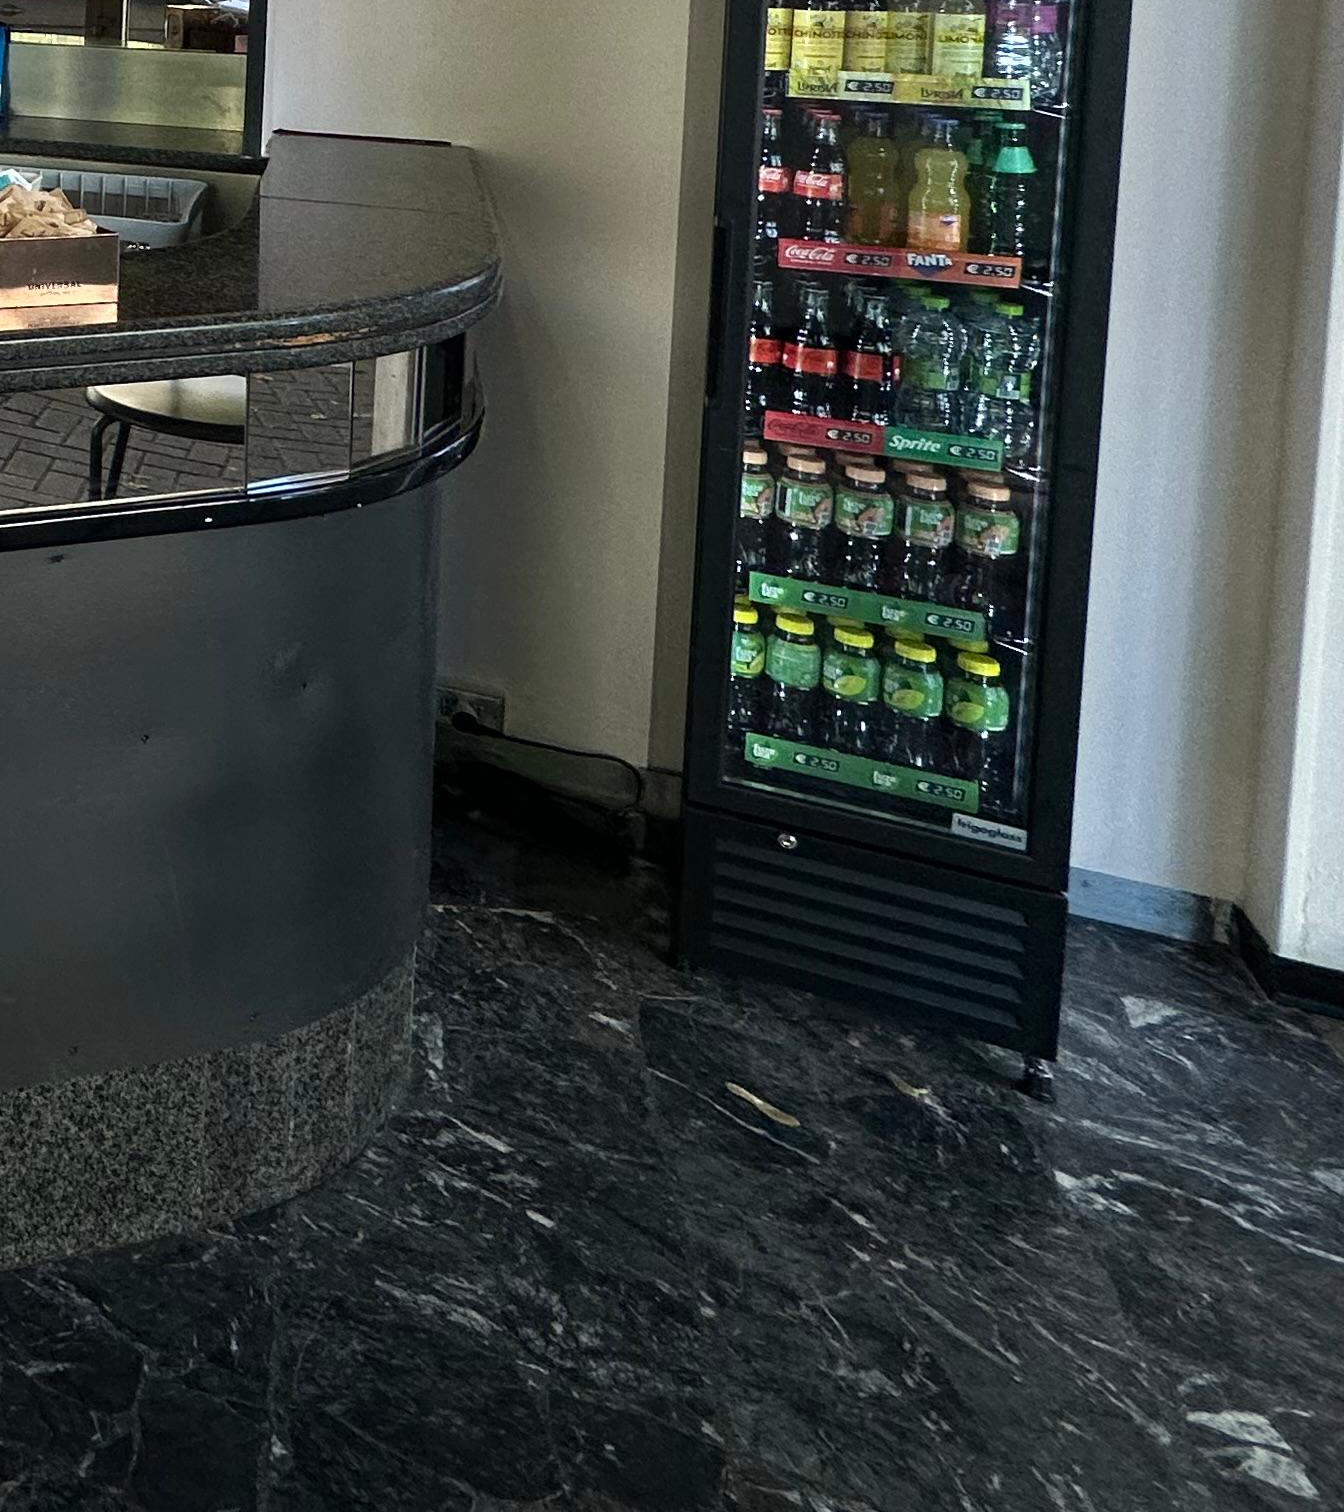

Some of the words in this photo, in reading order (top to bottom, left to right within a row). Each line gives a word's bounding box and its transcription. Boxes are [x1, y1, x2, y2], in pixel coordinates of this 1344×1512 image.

[785, 245, 836, 262] Coca-Cola
[906, 253, 953, 266] FANTA
[889, 435, 941, 453] Sprite
